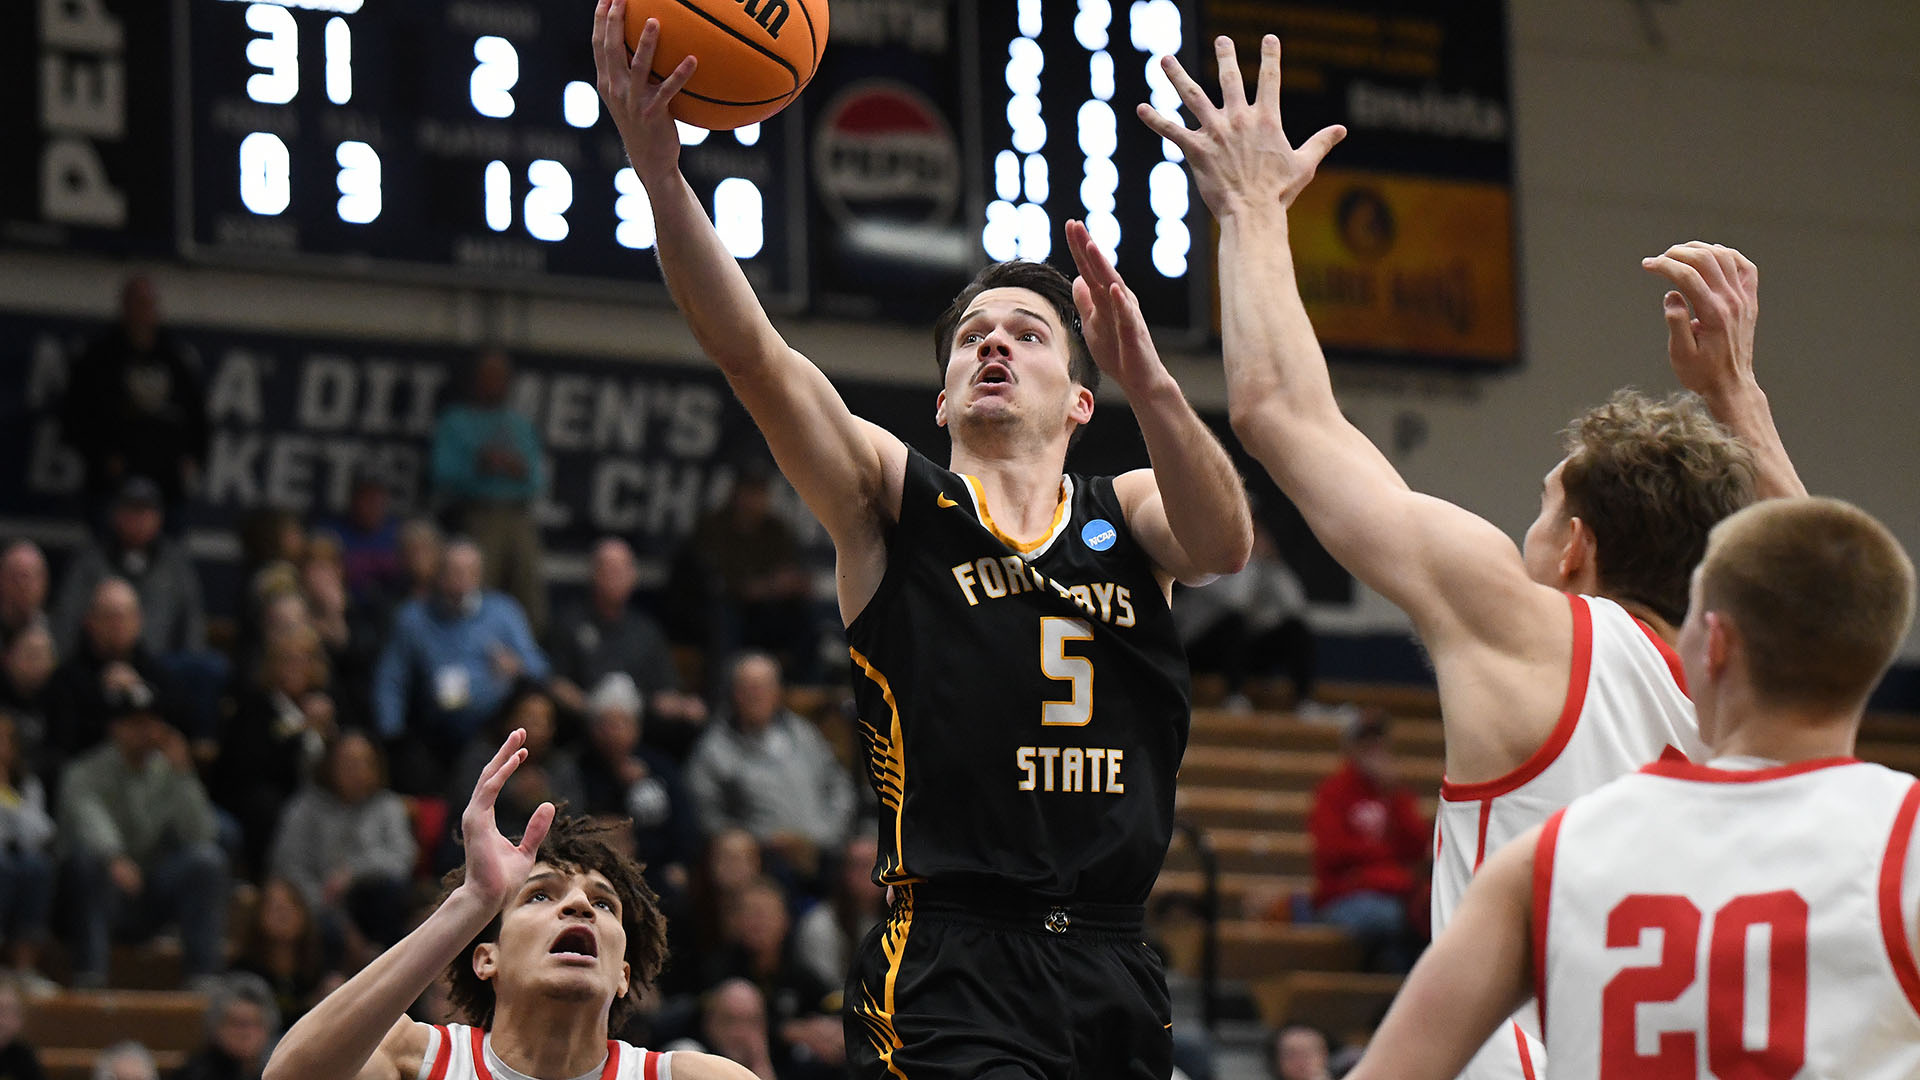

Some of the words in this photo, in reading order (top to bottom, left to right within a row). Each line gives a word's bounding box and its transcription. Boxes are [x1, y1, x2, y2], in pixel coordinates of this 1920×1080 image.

[245, 3, 352, 105] 31
[470, 35, 519, 118] 2
[240, 132, 291, 215] 0
[336, 141, 382, 224] 3
[485, 159, 573, 241] 12
[1088, 528, 1116, 547] NCAA
[1039, 616, 1095, 727] 5
[1015, 746, 1125, 794] STATE
[1599, 889, 1809, 1080] 20
